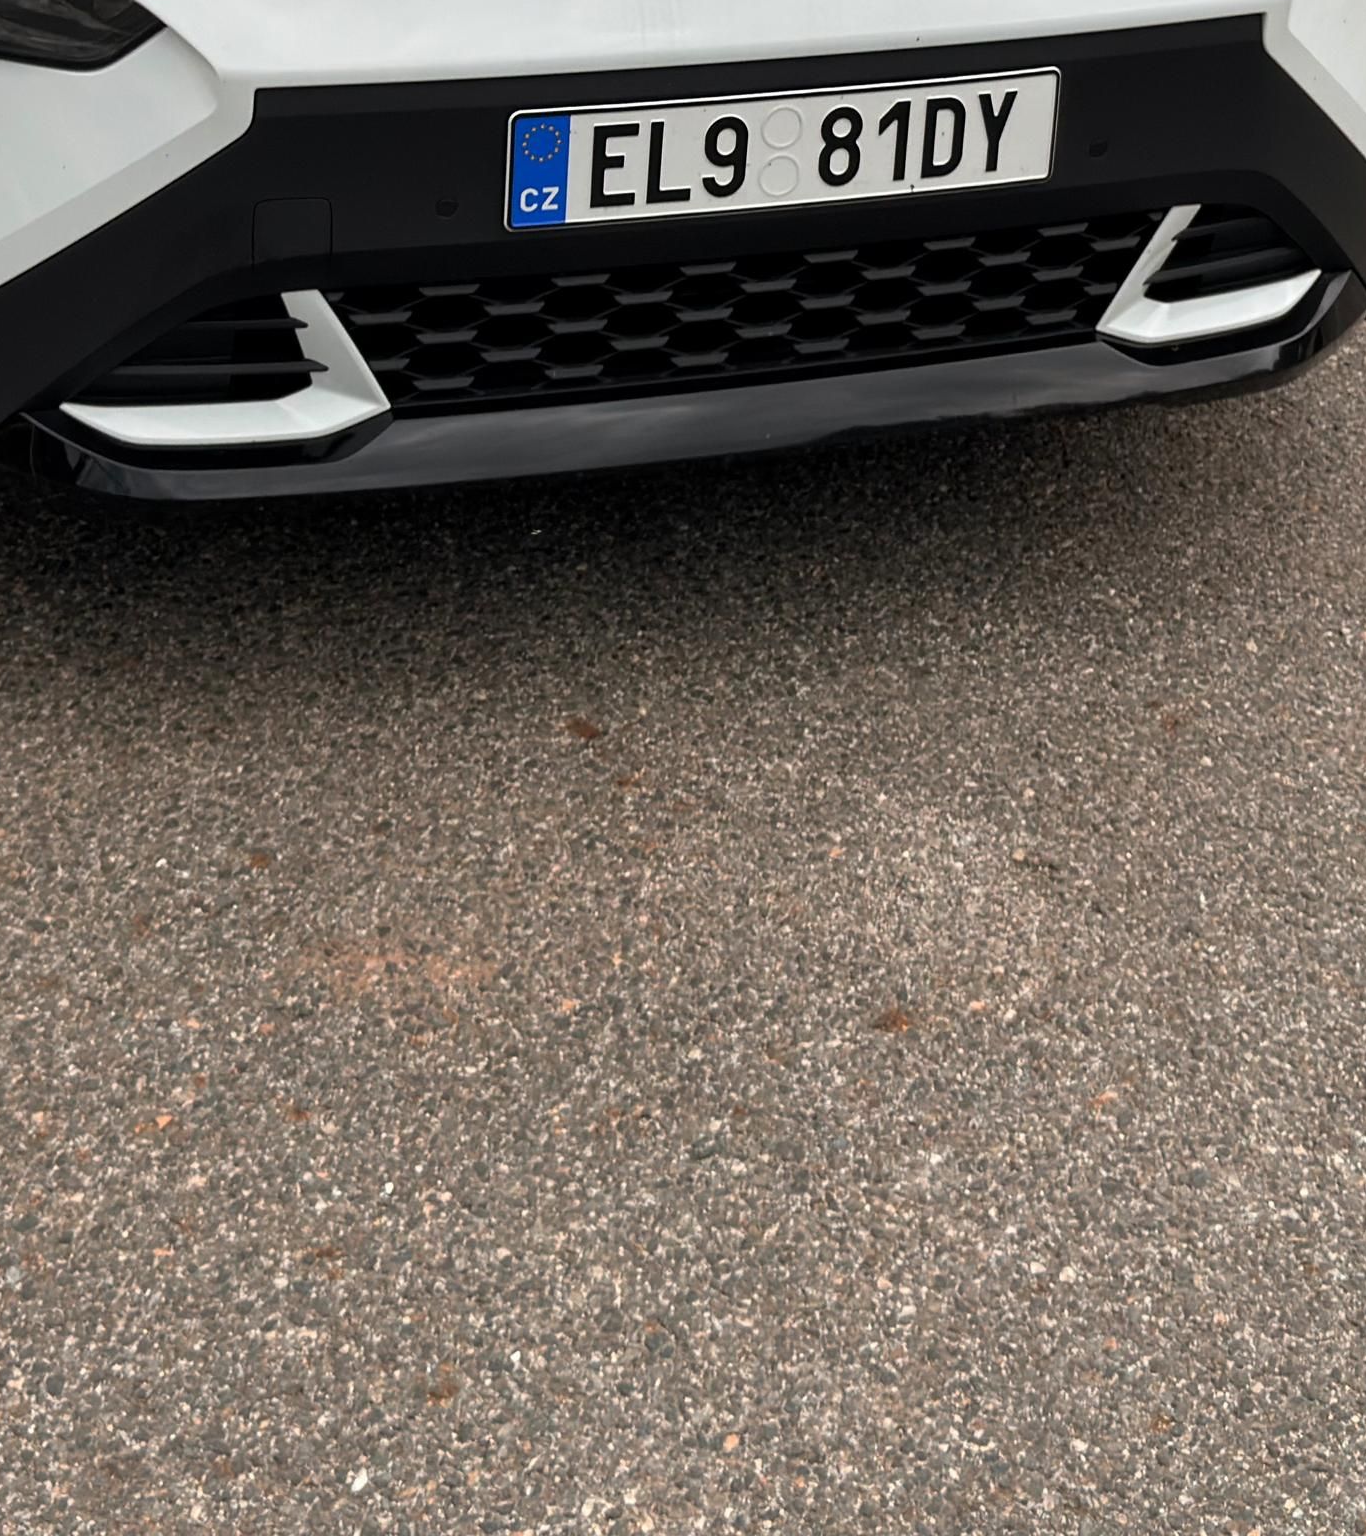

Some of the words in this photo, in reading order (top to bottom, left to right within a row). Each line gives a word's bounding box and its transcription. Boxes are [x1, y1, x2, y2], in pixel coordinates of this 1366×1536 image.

[519, 185, 559, 213] CZ
[590, 115, 750, 209] EL9
[817, 90, 1019, 188] 81DY
